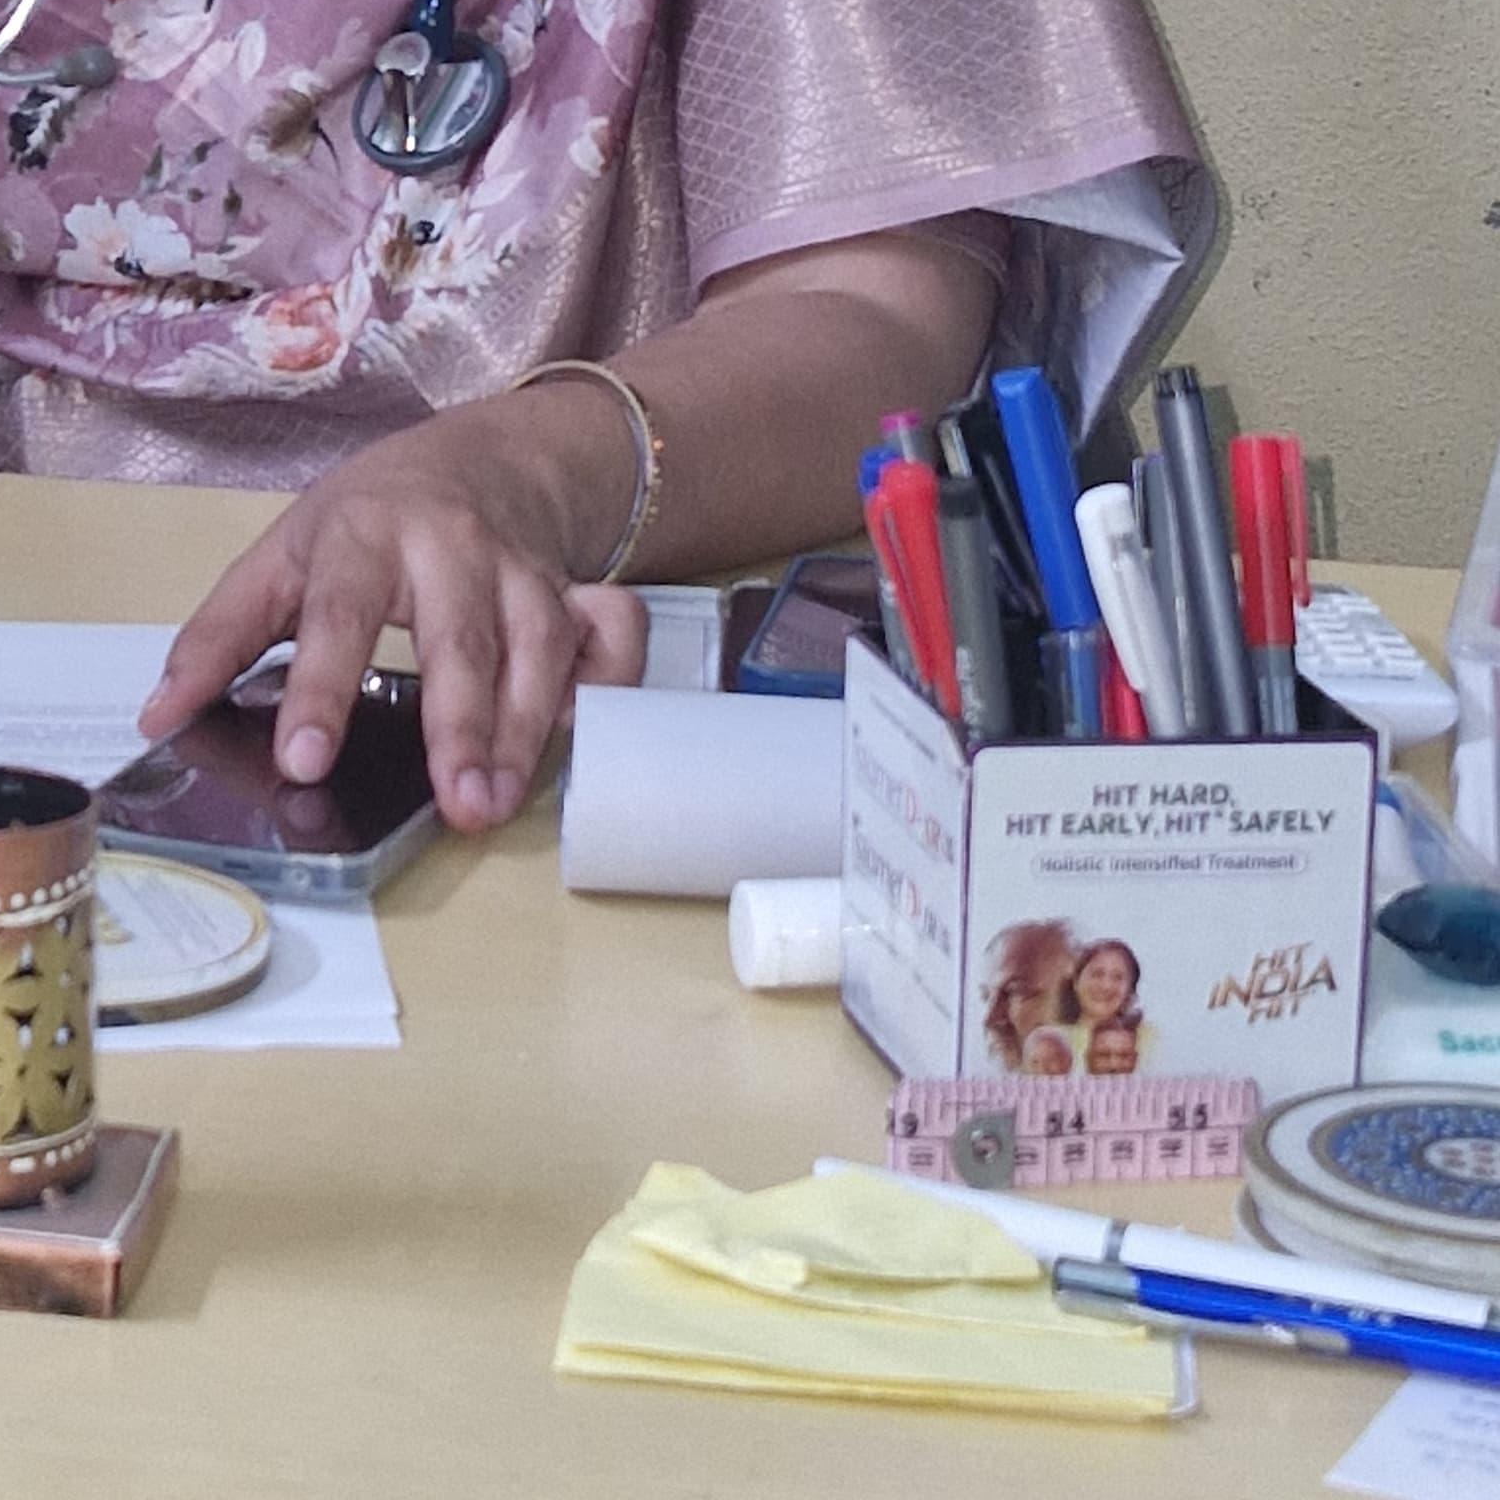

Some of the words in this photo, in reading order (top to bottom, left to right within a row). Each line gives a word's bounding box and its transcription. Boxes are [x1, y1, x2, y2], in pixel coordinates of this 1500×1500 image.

[1092, 784, 1139, 807] HIT
[1006, 813, 1052, 837] HIT
[1228, 809, 1335, 833] SAFELY
[1207, 852, 1296, 871] Treatment
[1438, 1029, 1500, 1054] Sac
